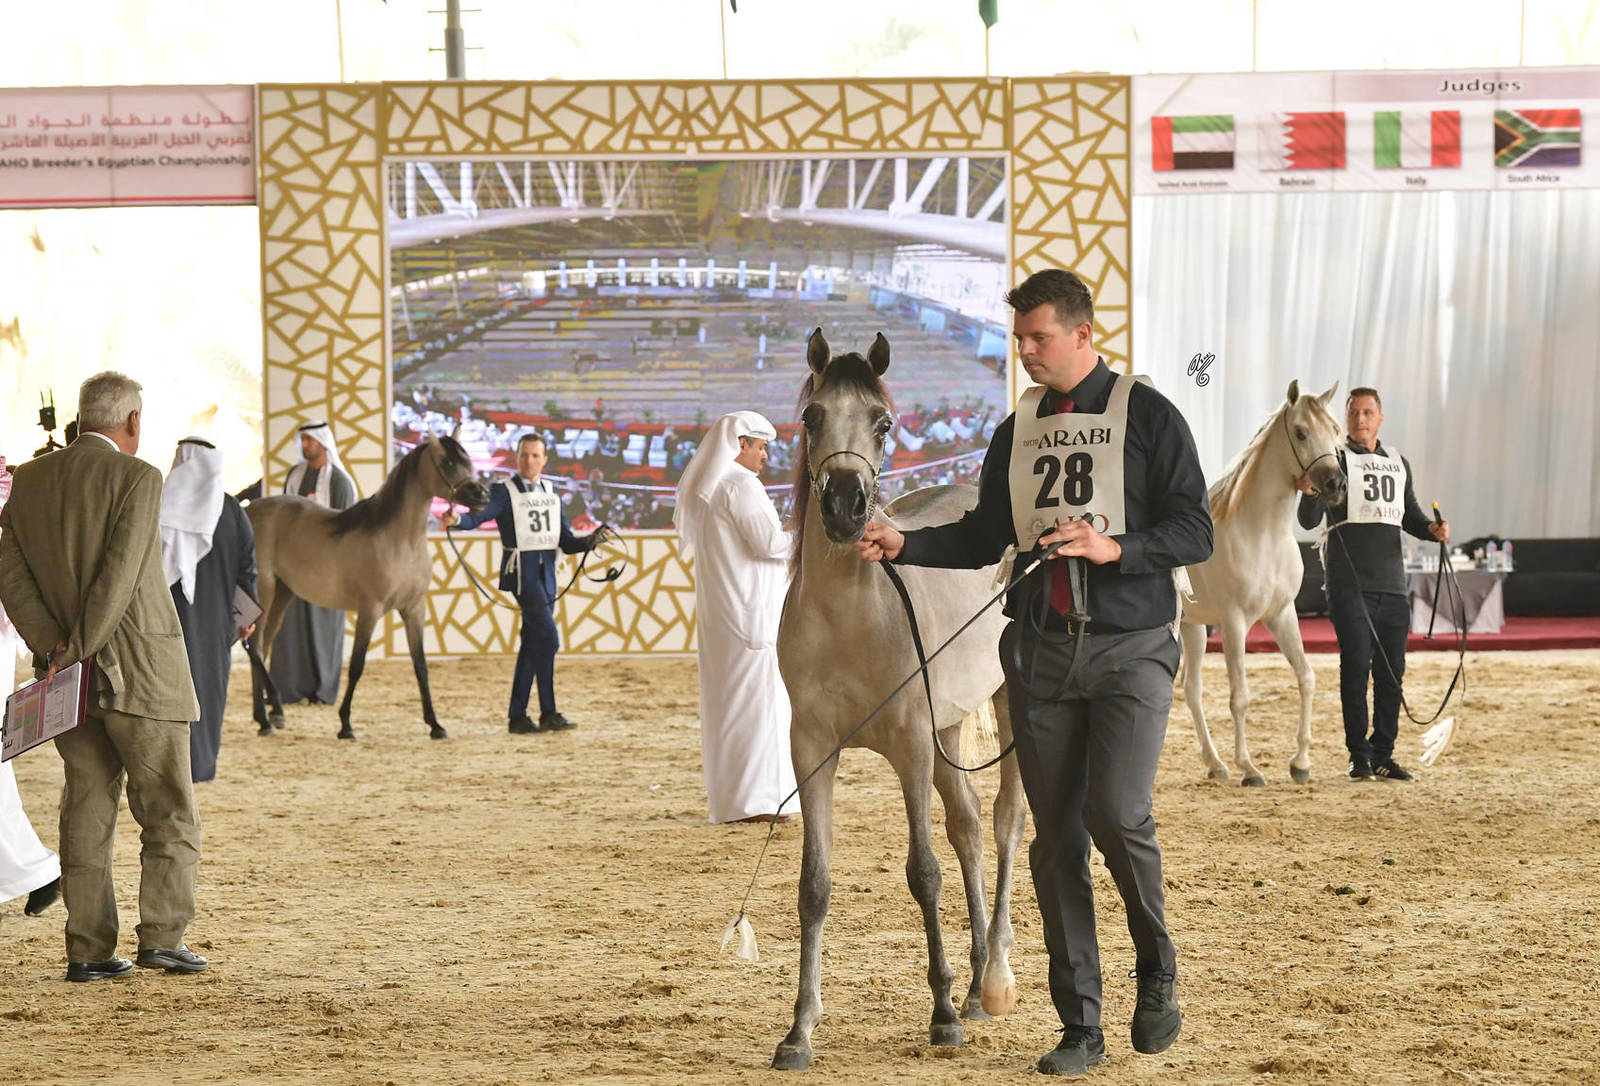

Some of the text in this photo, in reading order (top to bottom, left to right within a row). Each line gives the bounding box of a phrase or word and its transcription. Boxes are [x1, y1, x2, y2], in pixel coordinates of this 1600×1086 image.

[1439, 78, 1521, 95] Judges
[27, 112, 91, 130] الجواد
[101, 112, 172, 127] منظمة
[181, 111, 249, 128] بطولة
[0, 157, 28, 168] AHO
[97, 156, 155, 168] Egyptian
[158, 154, 250, 166] Championship
[1279, 177, 1316, 187] Bahrain
[1405, 175, 1427, 187] Italy
[1507, 173, 1560, 183] South Africa
[1038, 428, 1111, 449] ARABI
[1033, 452, 1094, 509] 28
[1363, 473, 1396, 503] 30
[528, 509, 551, 533] 31
[1374, 506, 1400, 519] AHO
